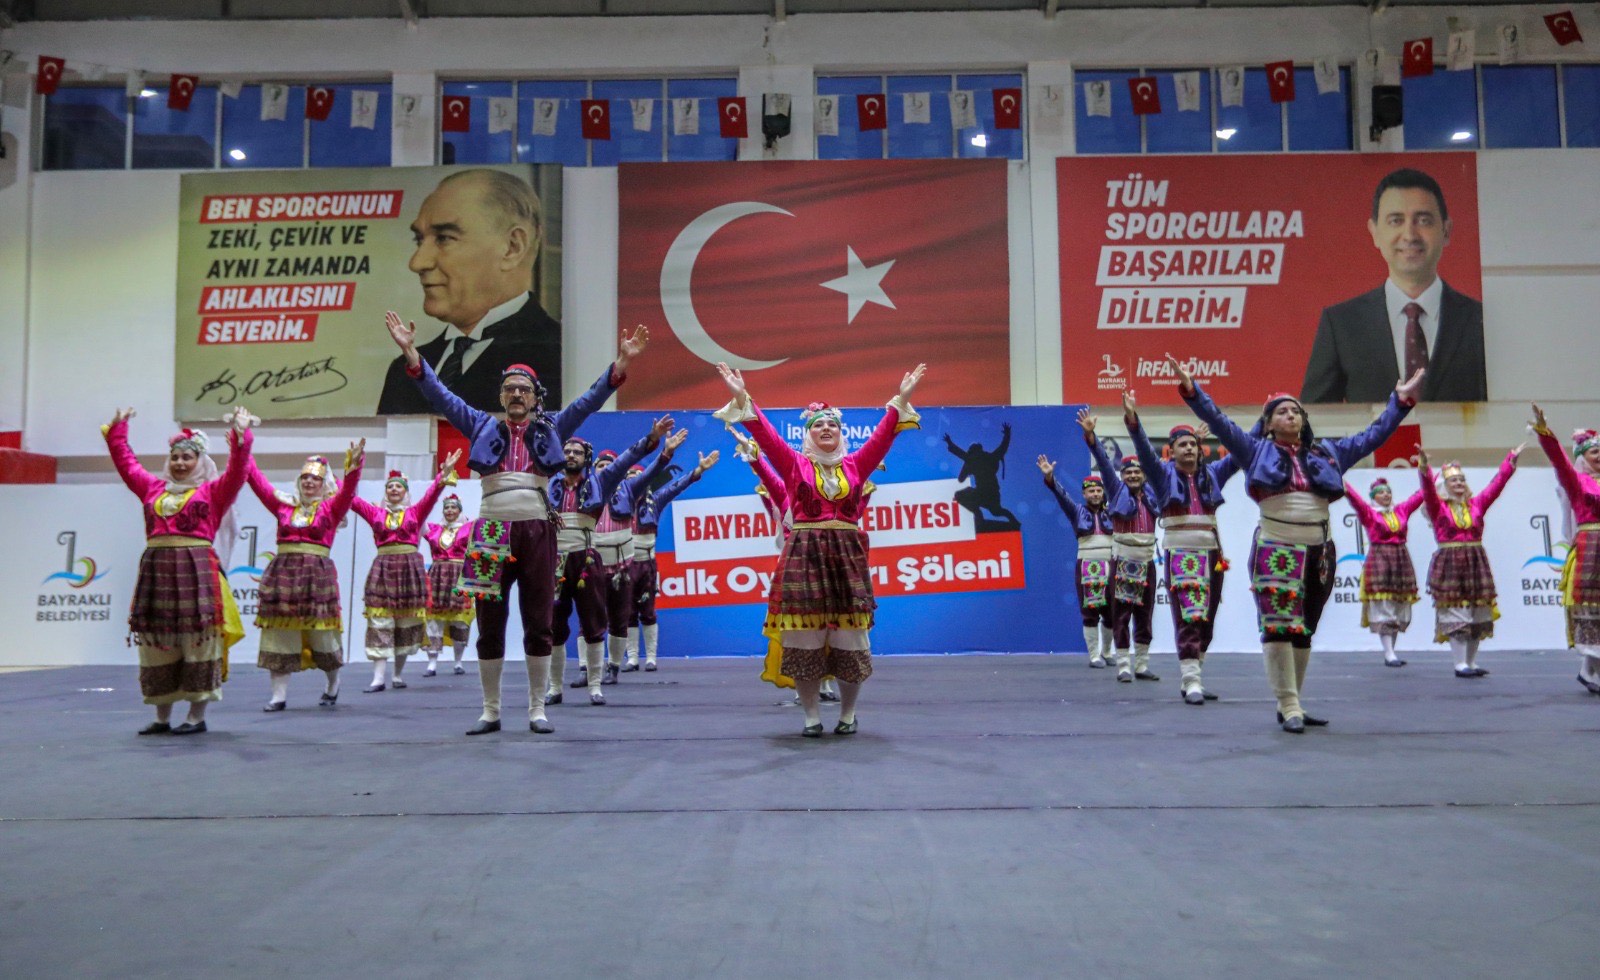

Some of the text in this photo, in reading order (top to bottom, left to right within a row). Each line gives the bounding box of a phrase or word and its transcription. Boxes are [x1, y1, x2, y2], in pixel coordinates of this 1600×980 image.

[1106, 173, 1169, 207] TÜM
[207, 194, 394, 220] BEN SPORCUNUN
[207, 221, 368, 251] ZEKİ, ÇEVİK VE
[1105, 210, 1304, 240] SPORCULARA
[206, 255, 371, 279] AYNI ZAMANDA
[1107, 249, 1275, 282] BAŞARILAR
[205, 285, 347, 310] AHLAKLISINI
[1106, 289, 1239, 324] DİLERİM.
[205, 314, 309, 343] SEVERİM.
[1186, 356, 1229, 377] ÖNAL
[684, 498, 960, 541] BAYRA EDİYESİ
[655, 568, 719, 597] alk
[896, 550, 1011, 591] Şöleni
[36, 607, 110, 621] BELEDİYESİ
[38, 594, 111, 606] BAYRAKLI
